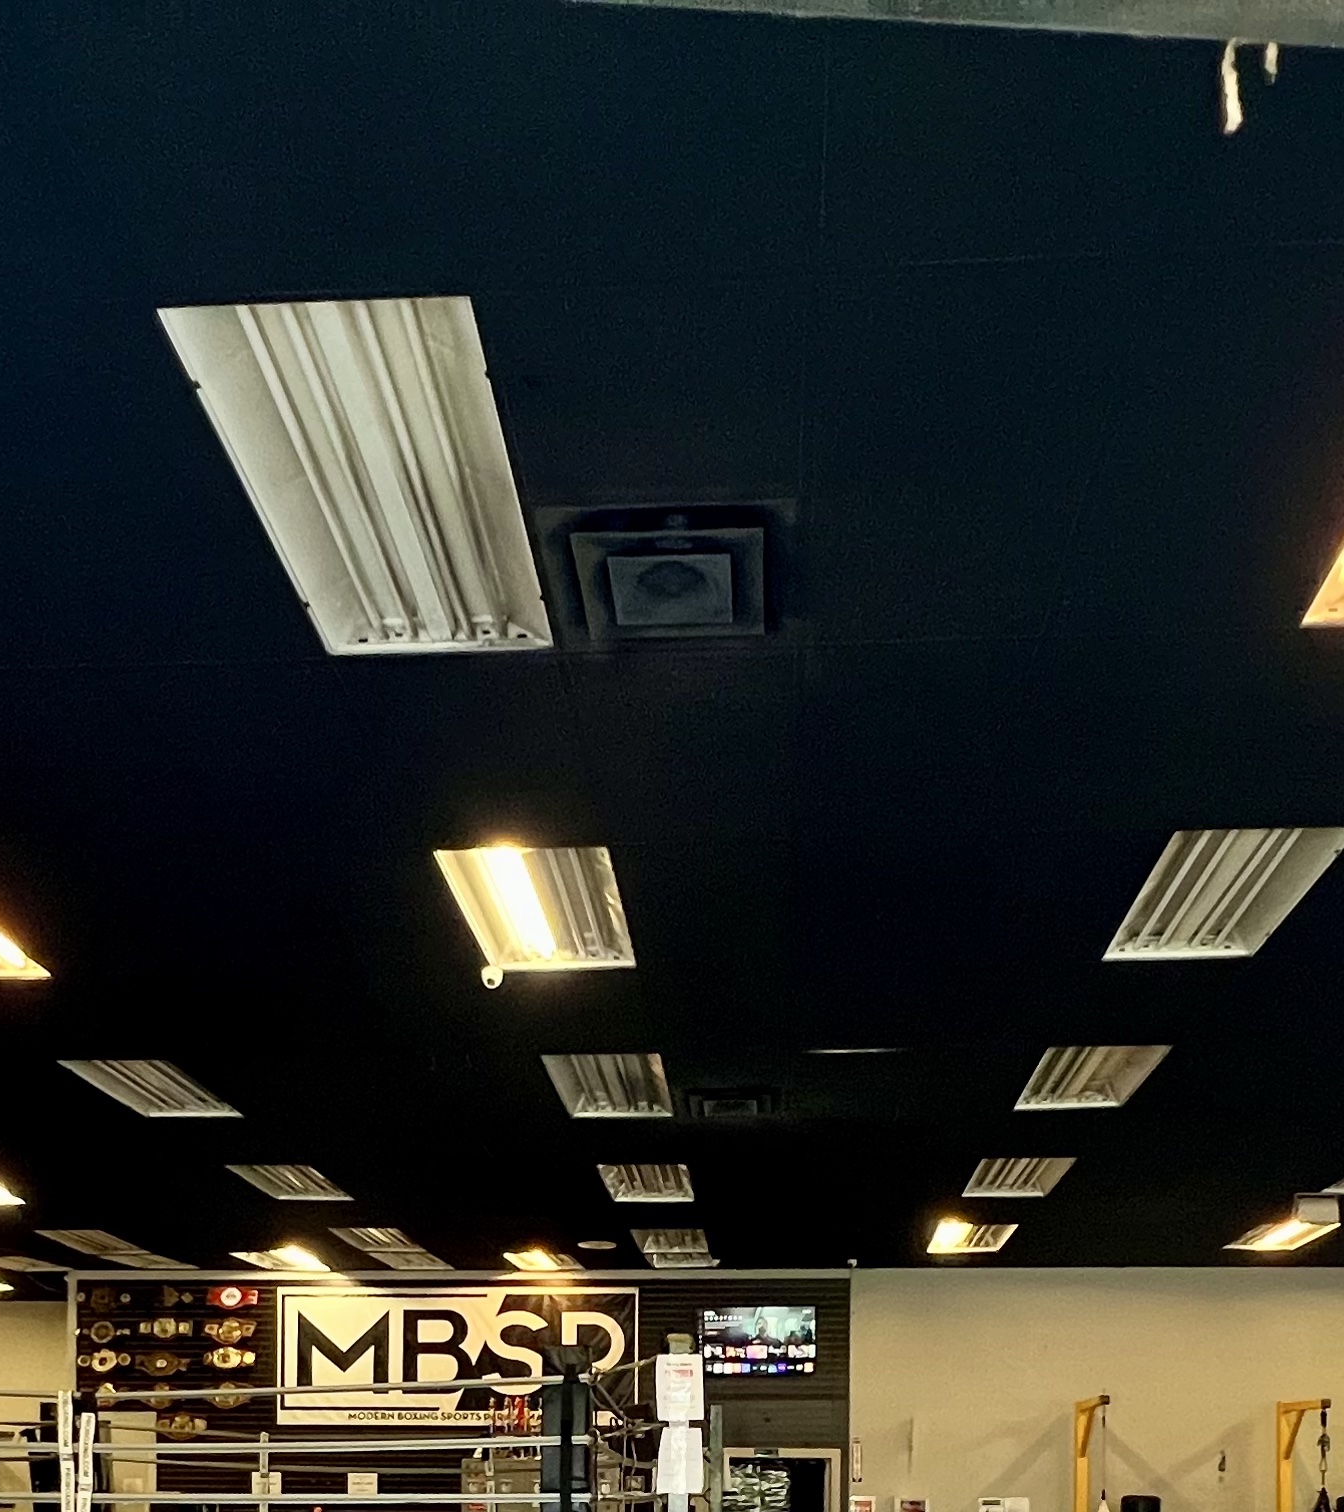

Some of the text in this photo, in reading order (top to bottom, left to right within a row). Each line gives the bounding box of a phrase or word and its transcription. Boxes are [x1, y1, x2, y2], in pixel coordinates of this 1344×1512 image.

[347, 1411, 395, 1421] MODERN
[397, 1411, 439, 1421] BOXING
[440, 1411, 482, 1421] SPORTS
